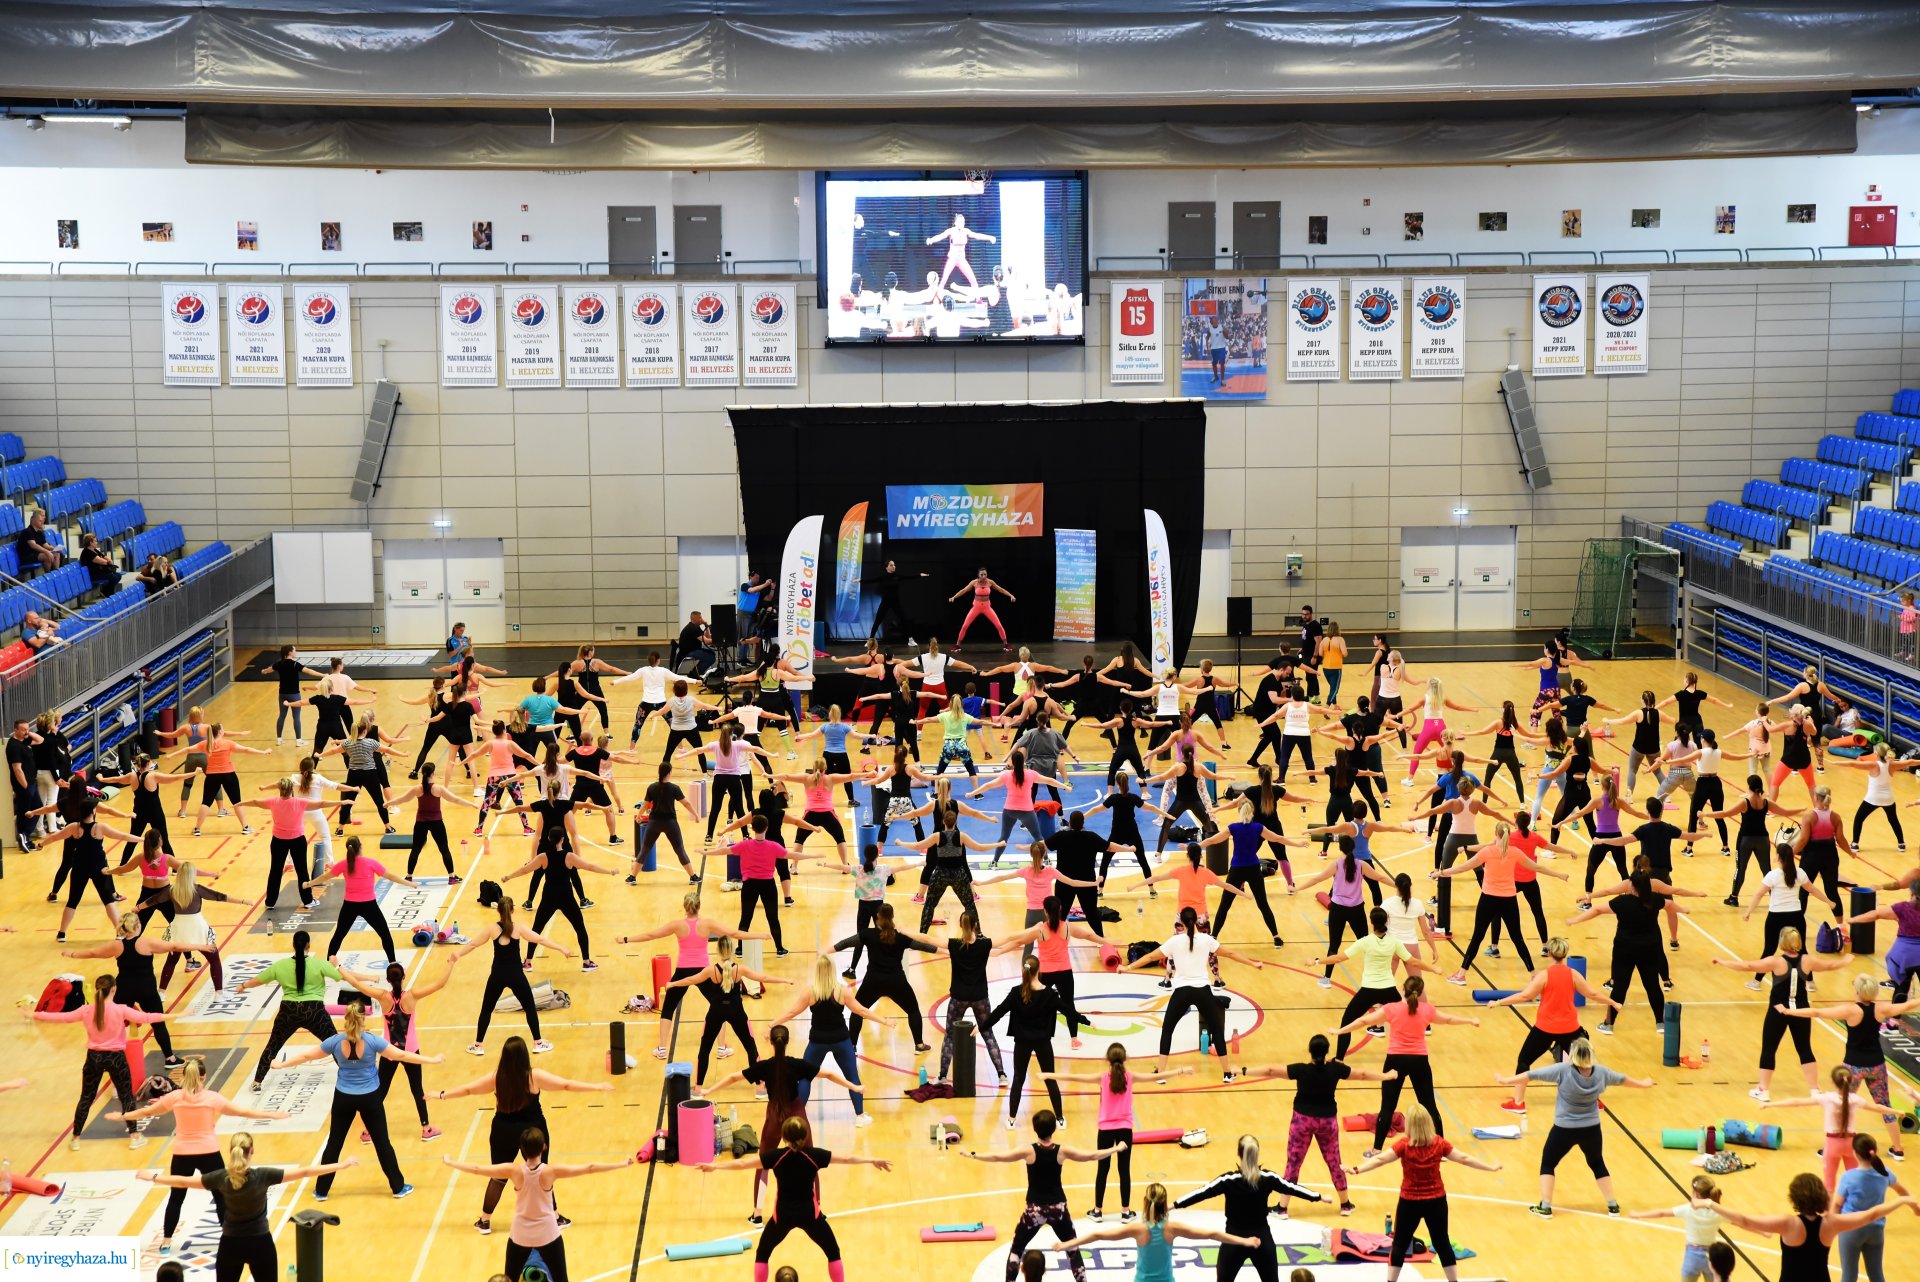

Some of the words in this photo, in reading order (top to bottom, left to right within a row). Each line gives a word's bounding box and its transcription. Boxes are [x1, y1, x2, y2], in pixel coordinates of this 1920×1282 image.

[1209, 286, 1227, 294] SITKU
[1292, 289, 1308, 309] BLUE
[1310, 288, 1336, 311] SHARKS
[1354, 289, 1371, 309] BLUE
[1373, 287, 1398, 311] SHARKS
[1417, 288, 1433, 308] BLUE
[1435, 286, 1461, 309] SHARKS
[1129, 306, 1145, 325] 15
[1119, 343, 1136, 351] Sitku
[1139, 343, 1156, 351] Ernő
[1425, 356, 1459, 365] HELYEZÉS
[1545, 354, 1579, 363] HELYEZÉS
[1607, 352, 1641, 361] HELYEZÉS
[1301, 358, 1335, 367] HELYEZÉS
[1363, 358, 1397, 367] HELYEZÉS
[177, 364, 214, 373] HELYEZÉS
[243, 364, 278, 373] HELYEZÉS
[311, 365, 347, 373] HELYEZÉS
[457, 363, 492, 373] HELYEZÉS
[518, 366, 554, 375] HELYEZÉS
[580, 365, 614, 374] HELYEZÉS
[639, 365, 674, 374] HELYEZÉS
[701, 364, 734, 373] HELYEZÉS
[760, 364, 792, 373] HELYEZÉS
[897, 510, 1034, 527] NYÍREGYHÁZA
[786, 572, 797, 636] NYÍREGYHÁZA
[796, 581, 812, 636] Többet
